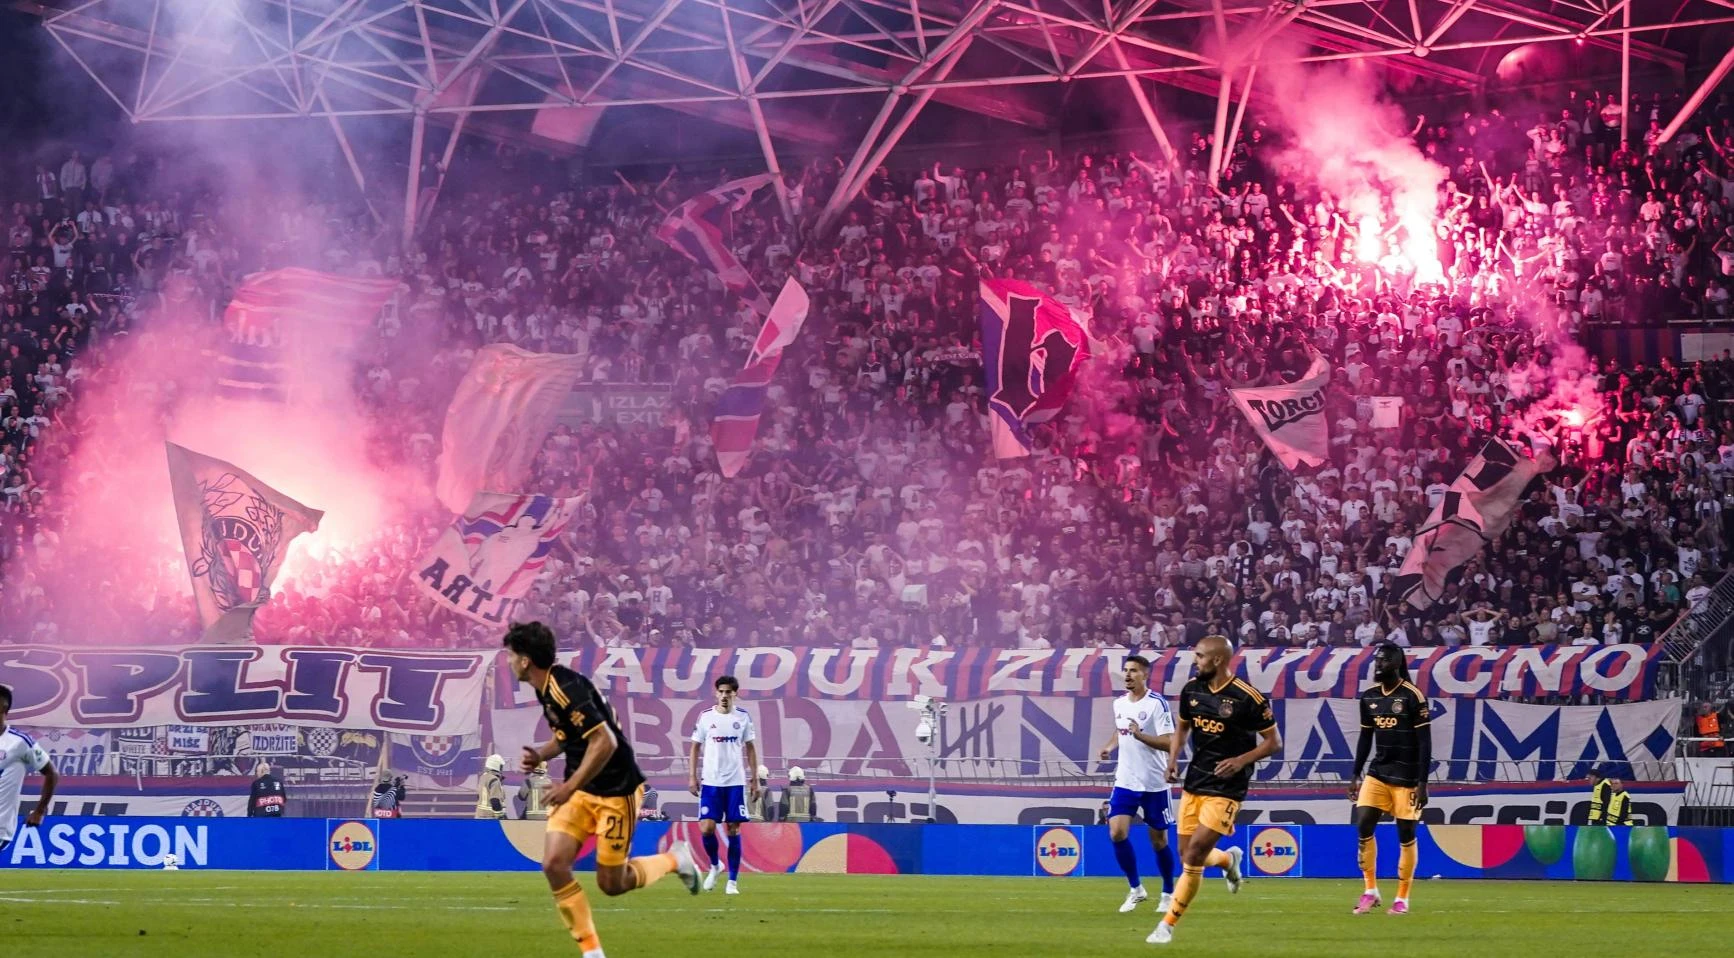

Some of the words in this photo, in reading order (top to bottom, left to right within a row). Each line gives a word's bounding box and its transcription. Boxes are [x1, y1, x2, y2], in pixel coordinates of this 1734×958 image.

[0, 646, 483, 730] SPLIT
[1409, 791, 1417, 807] 9
[738, 804, 747, 817] 6
[1225, 801, 1235, 820] 4
[605, 815, 625, 840] 21
[11, 823, 208, 866] ASSION
[333, 836, 373, 853] LIDL
[1039, 842, 1078, 858] LIDL
[1254, 842, 1296, 858] LIDL
